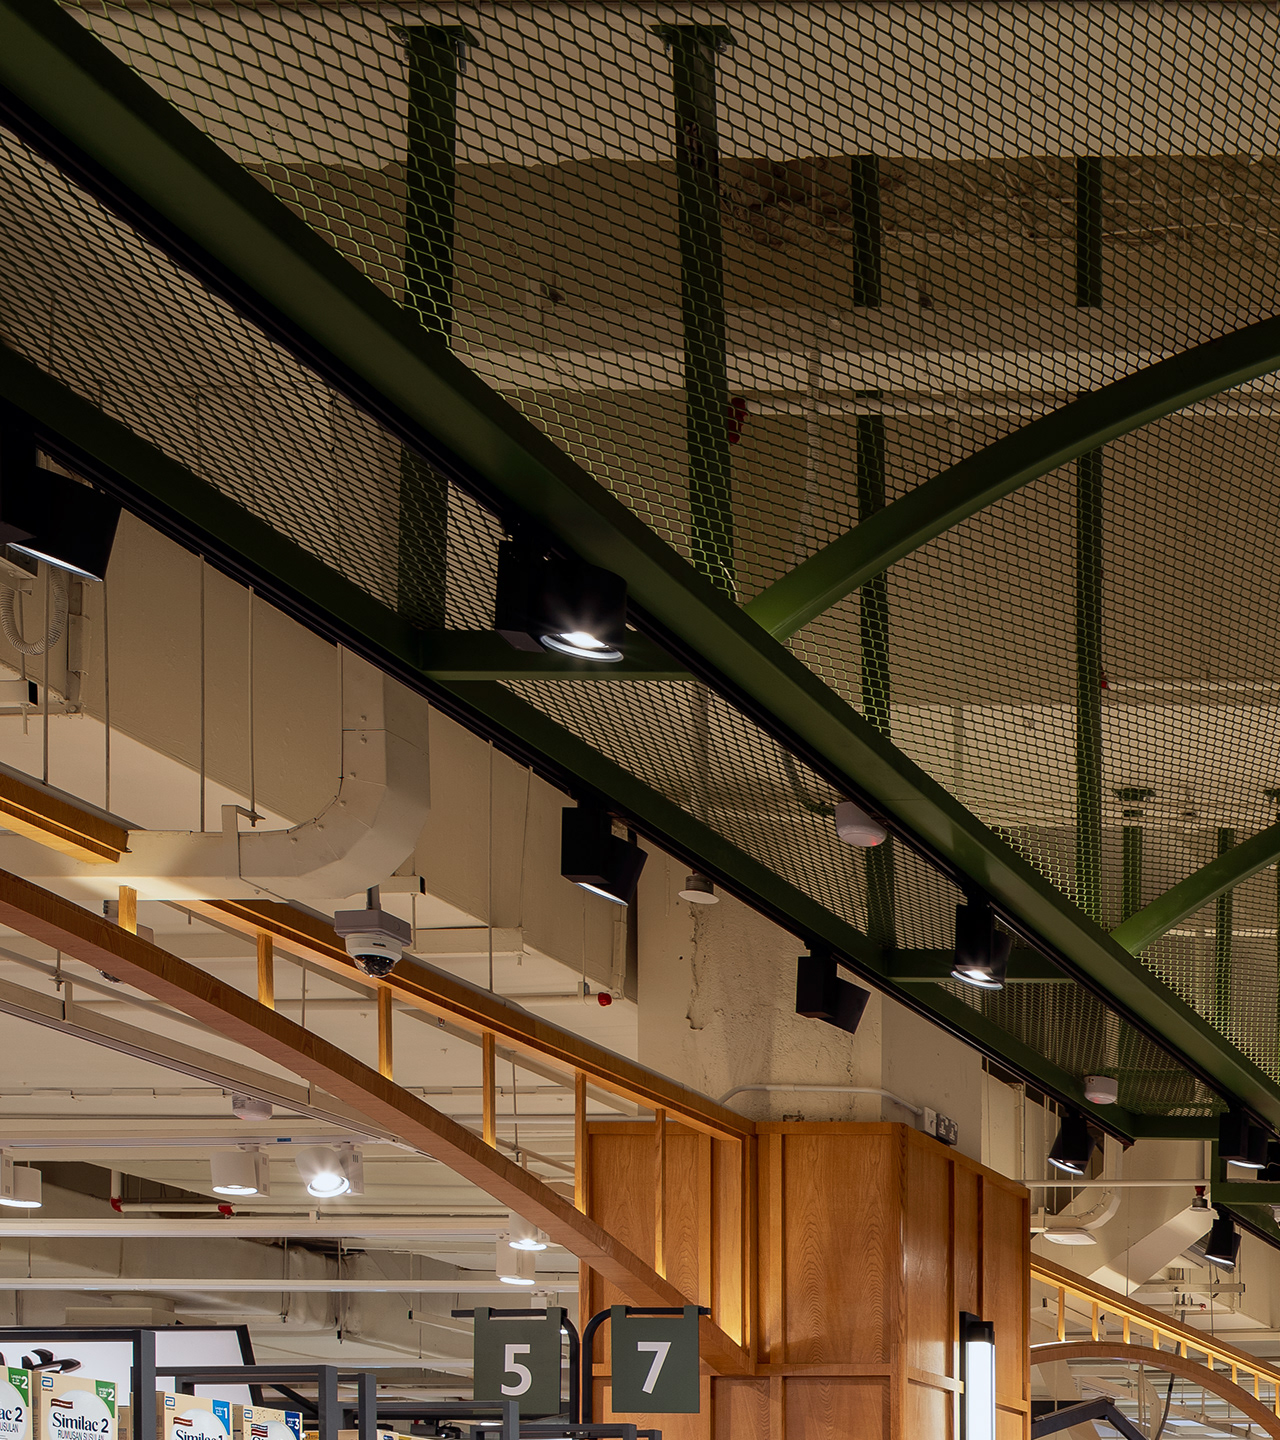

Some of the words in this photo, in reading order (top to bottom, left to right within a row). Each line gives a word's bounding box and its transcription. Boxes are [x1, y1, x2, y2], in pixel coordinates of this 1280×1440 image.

[501, 1344, 532, 1396] 5
[637, 1342, 672, 1394] 7
[21, 1376, 28, 1389] 2
[108, 1388, 115, 1401] 2
[15, 1406, 23, 1422] 2
[52, 1412, 98, 1432] Similac
[101, 1418, 109, 1433] 2
[294, 1419, 300, 1430] 3
